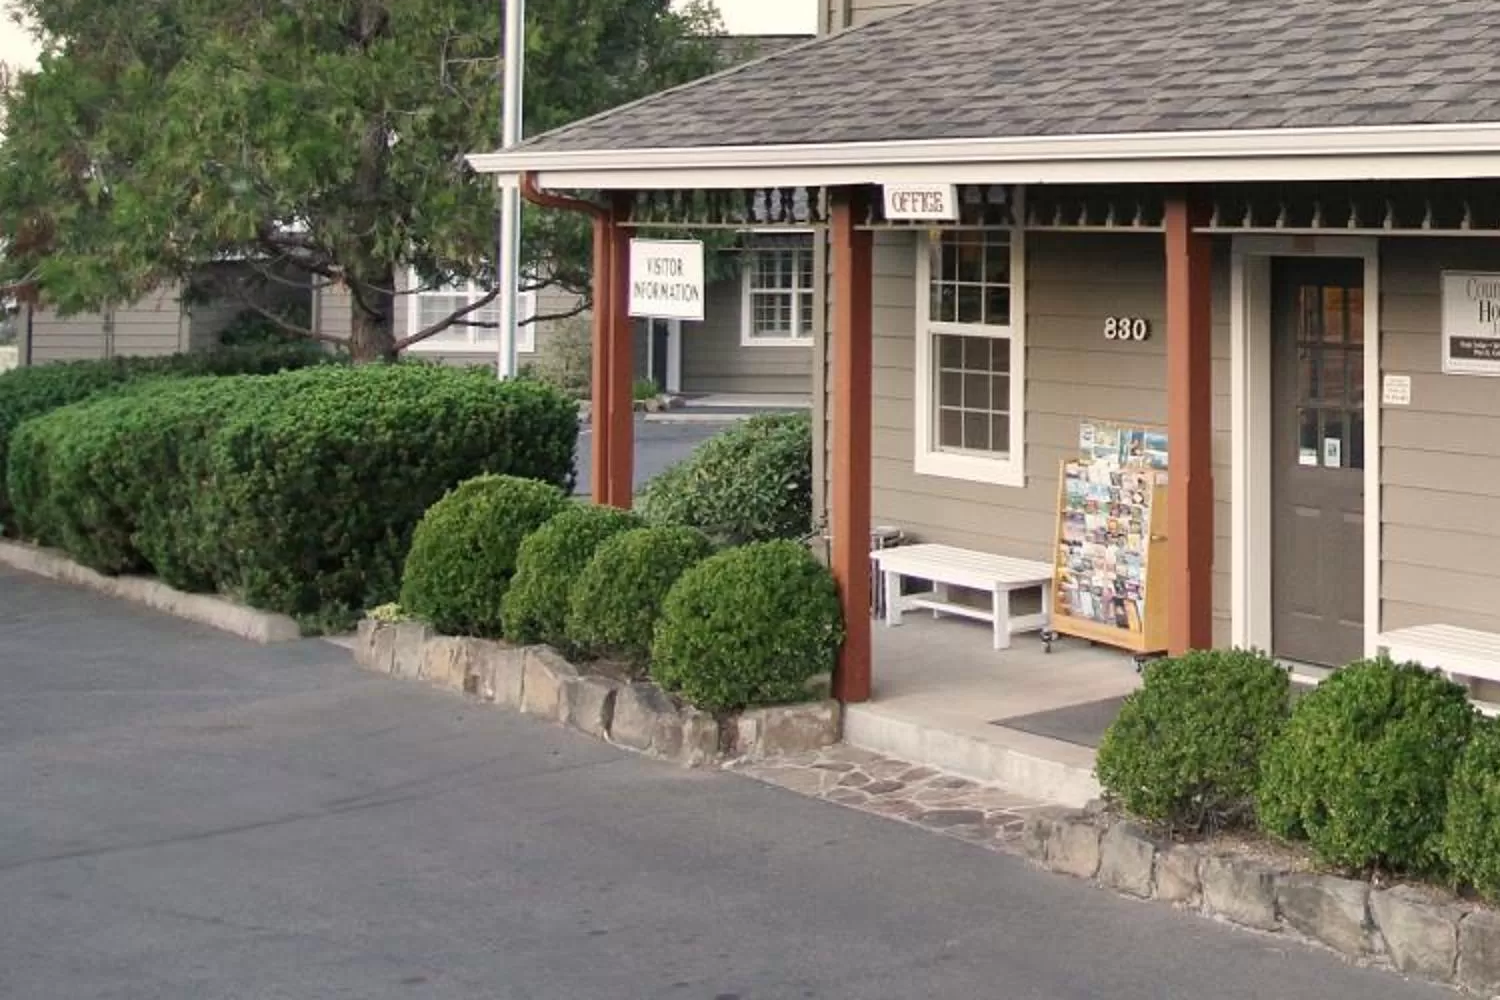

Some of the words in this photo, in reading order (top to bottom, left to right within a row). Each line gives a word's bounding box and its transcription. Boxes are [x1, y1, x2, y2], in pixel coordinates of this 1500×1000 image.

[891, 191, 944, 213] OFFICE
[646, 257, 684, 276] VISITOR
[634, 281, 700, 302] INFORMATION
[1104, 316, 1146, 341] 830
